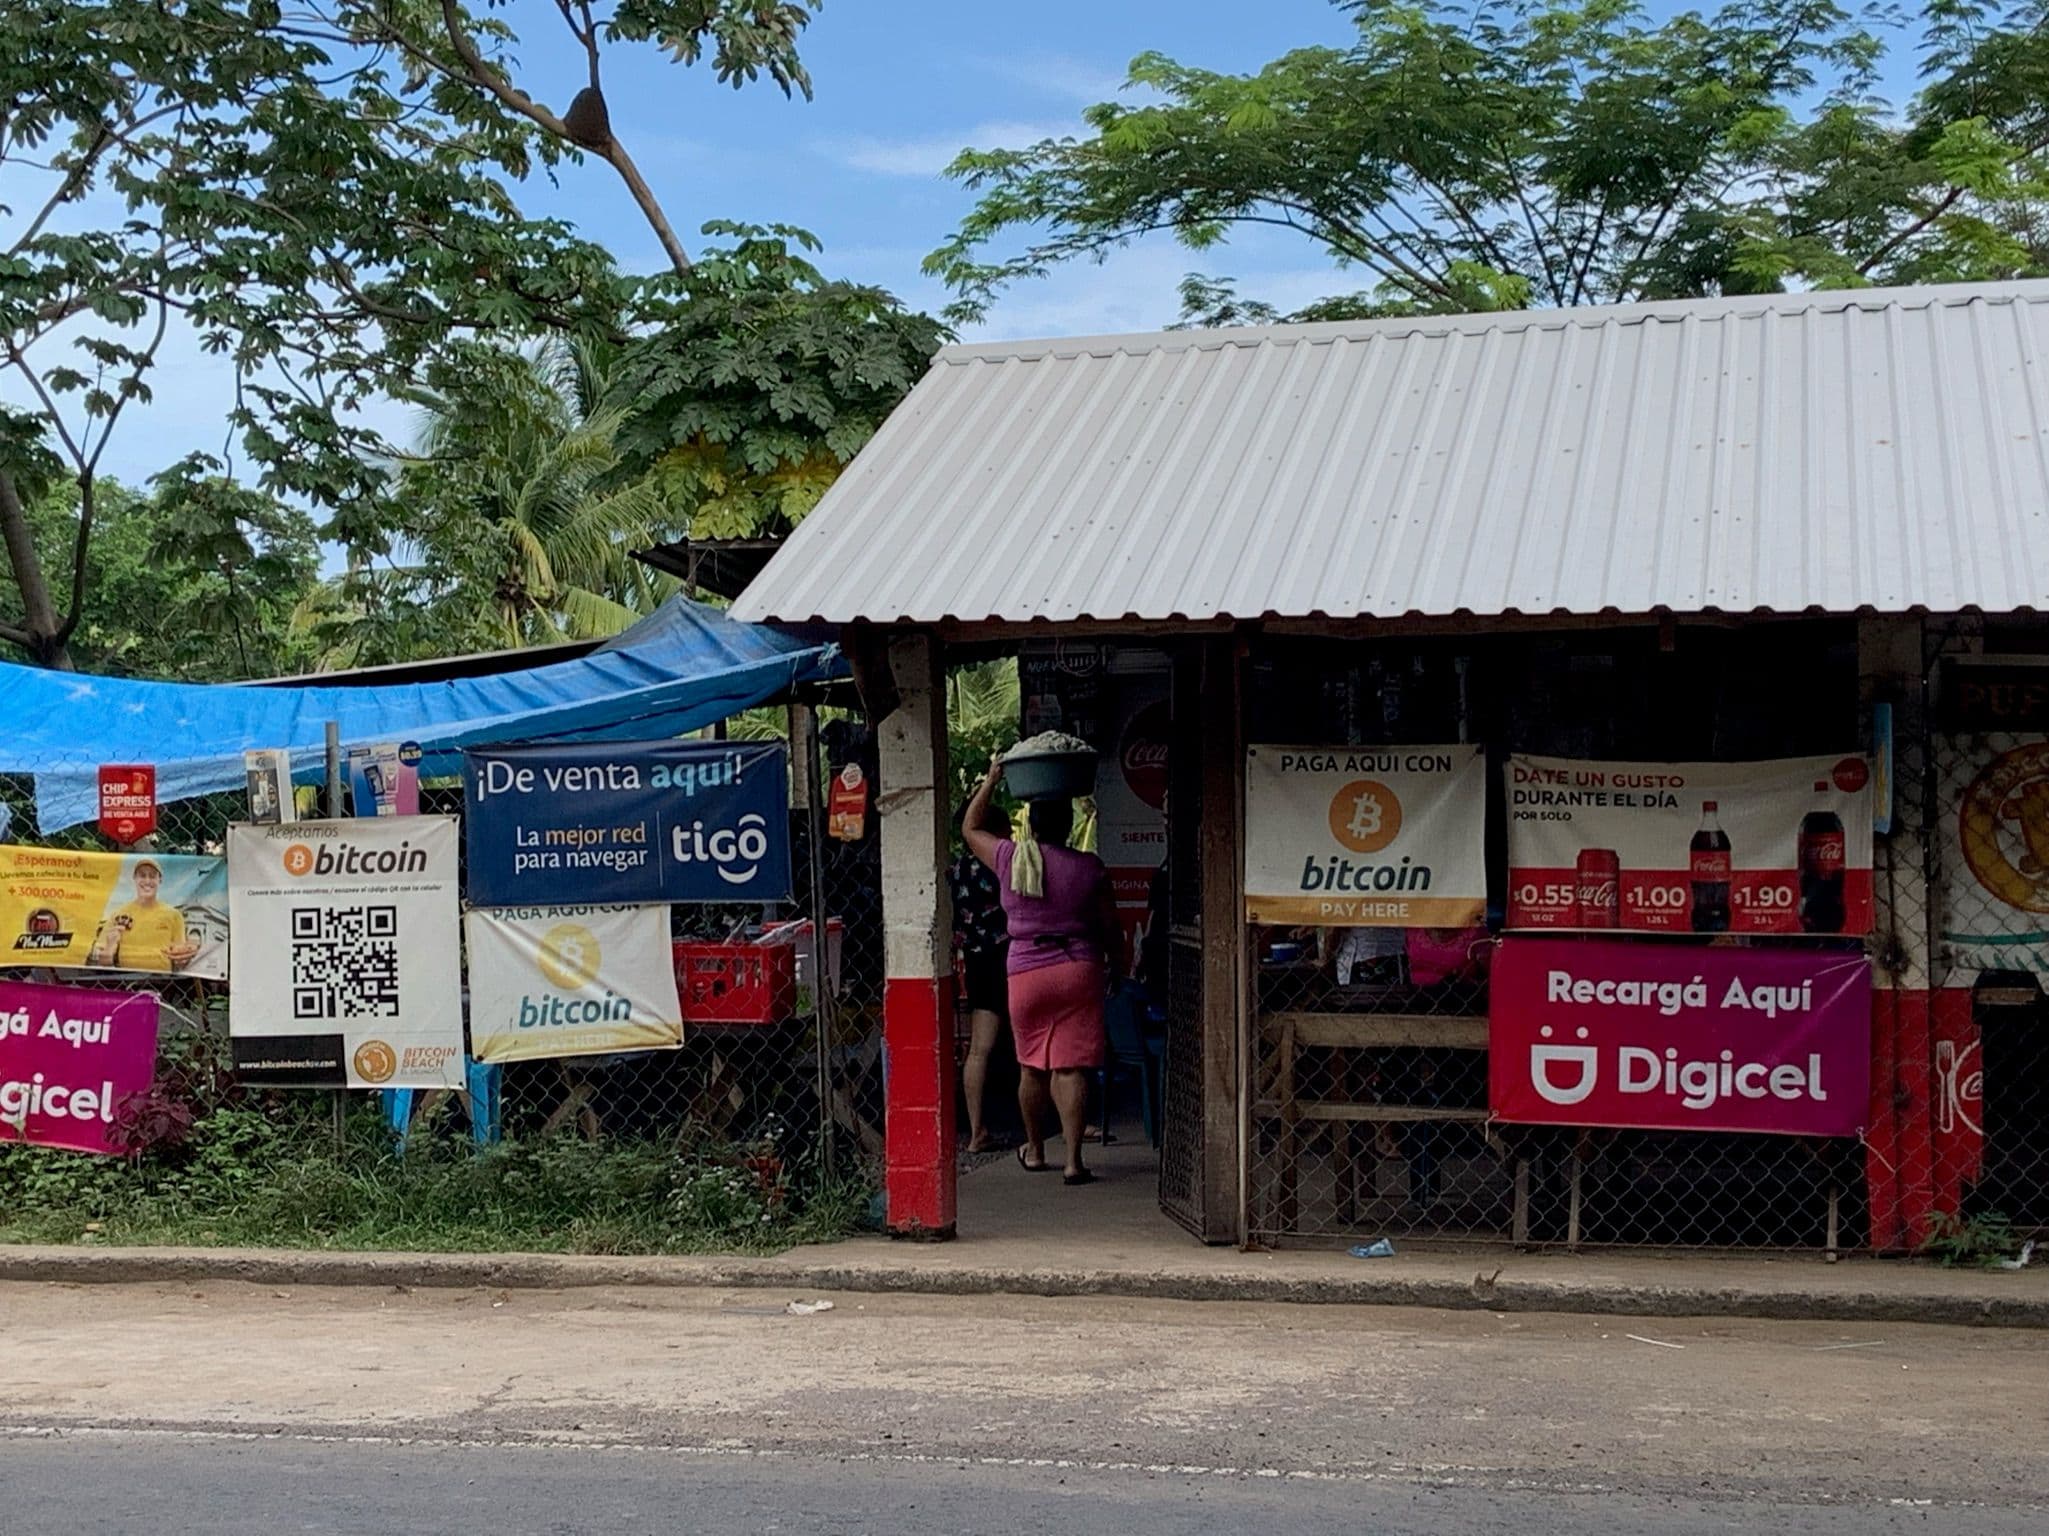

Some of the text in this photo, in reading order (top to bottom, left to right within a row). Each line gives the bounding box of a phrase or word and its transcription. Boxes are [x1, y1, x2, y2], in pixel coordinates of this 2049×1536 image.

[1281, 755, 1452, 773] PAGA AQUI CON
[102, 783, 129, 794] CHIP
[477, 752, 744, 802] ¡De venta aquí!
[1514, 768, 1685, 788] DATE UN GUSTO
[102, 795, 152, 807] EXPRESS
[1514, 790, 1679, 808] DURANTE EL DÍA
[1514, 811, 1573, 822] POR SOLO
[264, 825, 340, 841] Aceptamos
[516, 821, 647, 851] La mejor red
[1121, 832, 1165, 844] SIENTE
[314, 840, 428, 875] bitcoin
[671, 814, 768, 884] tigo
[515, 849, 649, 875] para navegar
[1299, 855, 1432, 892] bitcoin
[1513, 883, 1575, 906] $0.55
[1625, 885, 1687, 908] $1.00
[1733, 885, 1793, 908] $1.90
[493, 906, 543, 921] PAGA
[1321, 902, 1409, 918] PAY HERE
[1547, 970, 1813, 1019] Recargá Aquí
[519, 991, 633, 1028] bitcoin
[37, 1009, 113, 1048] Aquí
[401, 1058, 445, 1068] BEACH
[403, 1047, 458, 1058] BITCOIN
[1618, 1046, 1828, 1110] Digicel
